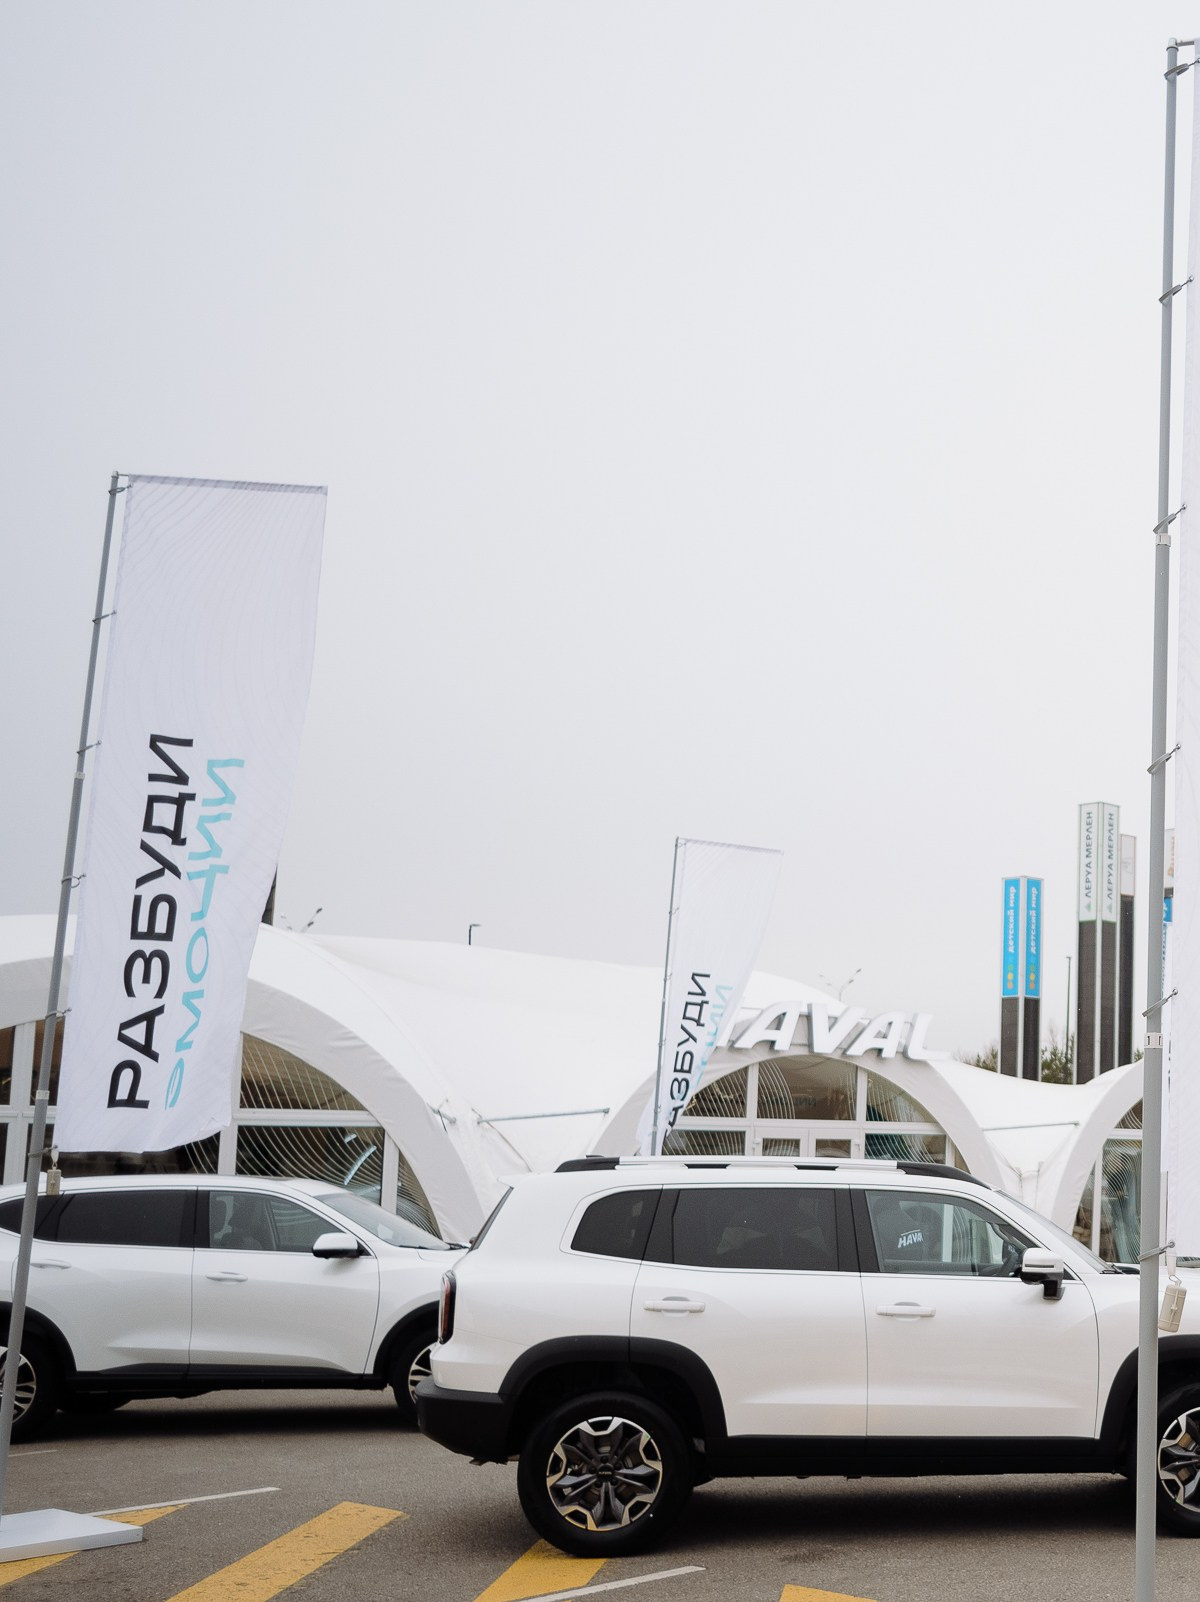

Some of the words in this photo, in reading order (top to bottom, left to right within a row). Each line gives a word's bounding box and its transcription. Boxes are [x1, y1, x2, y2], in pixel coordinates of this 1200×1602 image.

[1085, 811, 1093, 859] МЕРЛЕН
[106, 733, 197, 1109] РАЗБУДИ
[164, 757, 246, 1110] ЭМОЦИИ
[667, 972, 711, 1135] АЗБУДИ
[897, 1232, 924, 1249] HAVA
